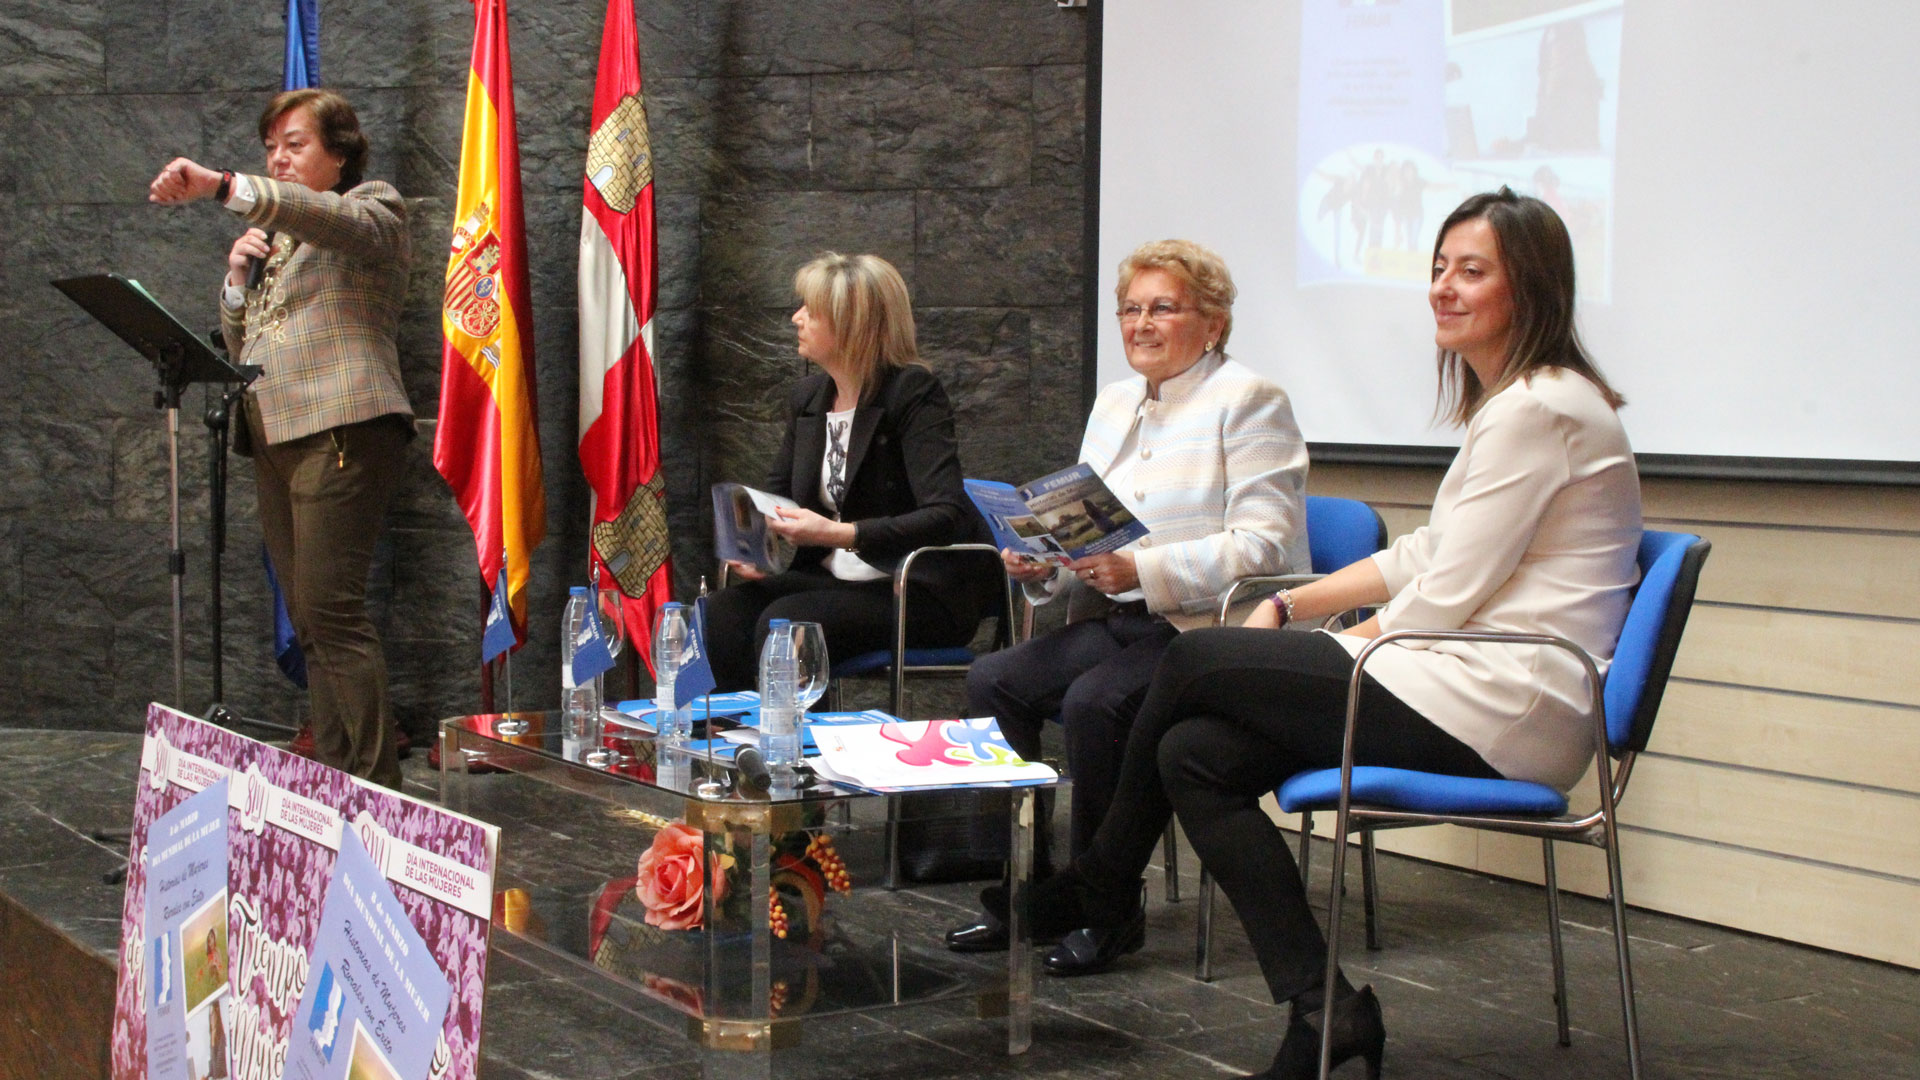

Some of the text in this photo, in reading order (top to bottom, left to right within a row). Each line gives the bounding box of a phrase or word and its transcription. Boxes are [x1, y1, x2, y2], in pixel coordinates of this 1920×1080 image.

[1043, 471, 1081, 490] FEMUR
[588, 611, 600, 640] FEMUR
[691, 628, 700, 660] FEMUR
[280, 809, 324, 836] DE LAS MUJERES
[292, 801, 333, 828] INTERNACIONAL
[404, 865, 462, 899] DE LAS MUJERES
[407, 851, 475, 890] DÍA INTERNACIONAL
[384, 912, 409, 957] MARZO
[233, 896, 308, 1013] Tiempo
[354, 892, 385, 949] MUNDIAL
[394, 960, 404, 982] LA
[404, 977, 430, 1024] MUJER
